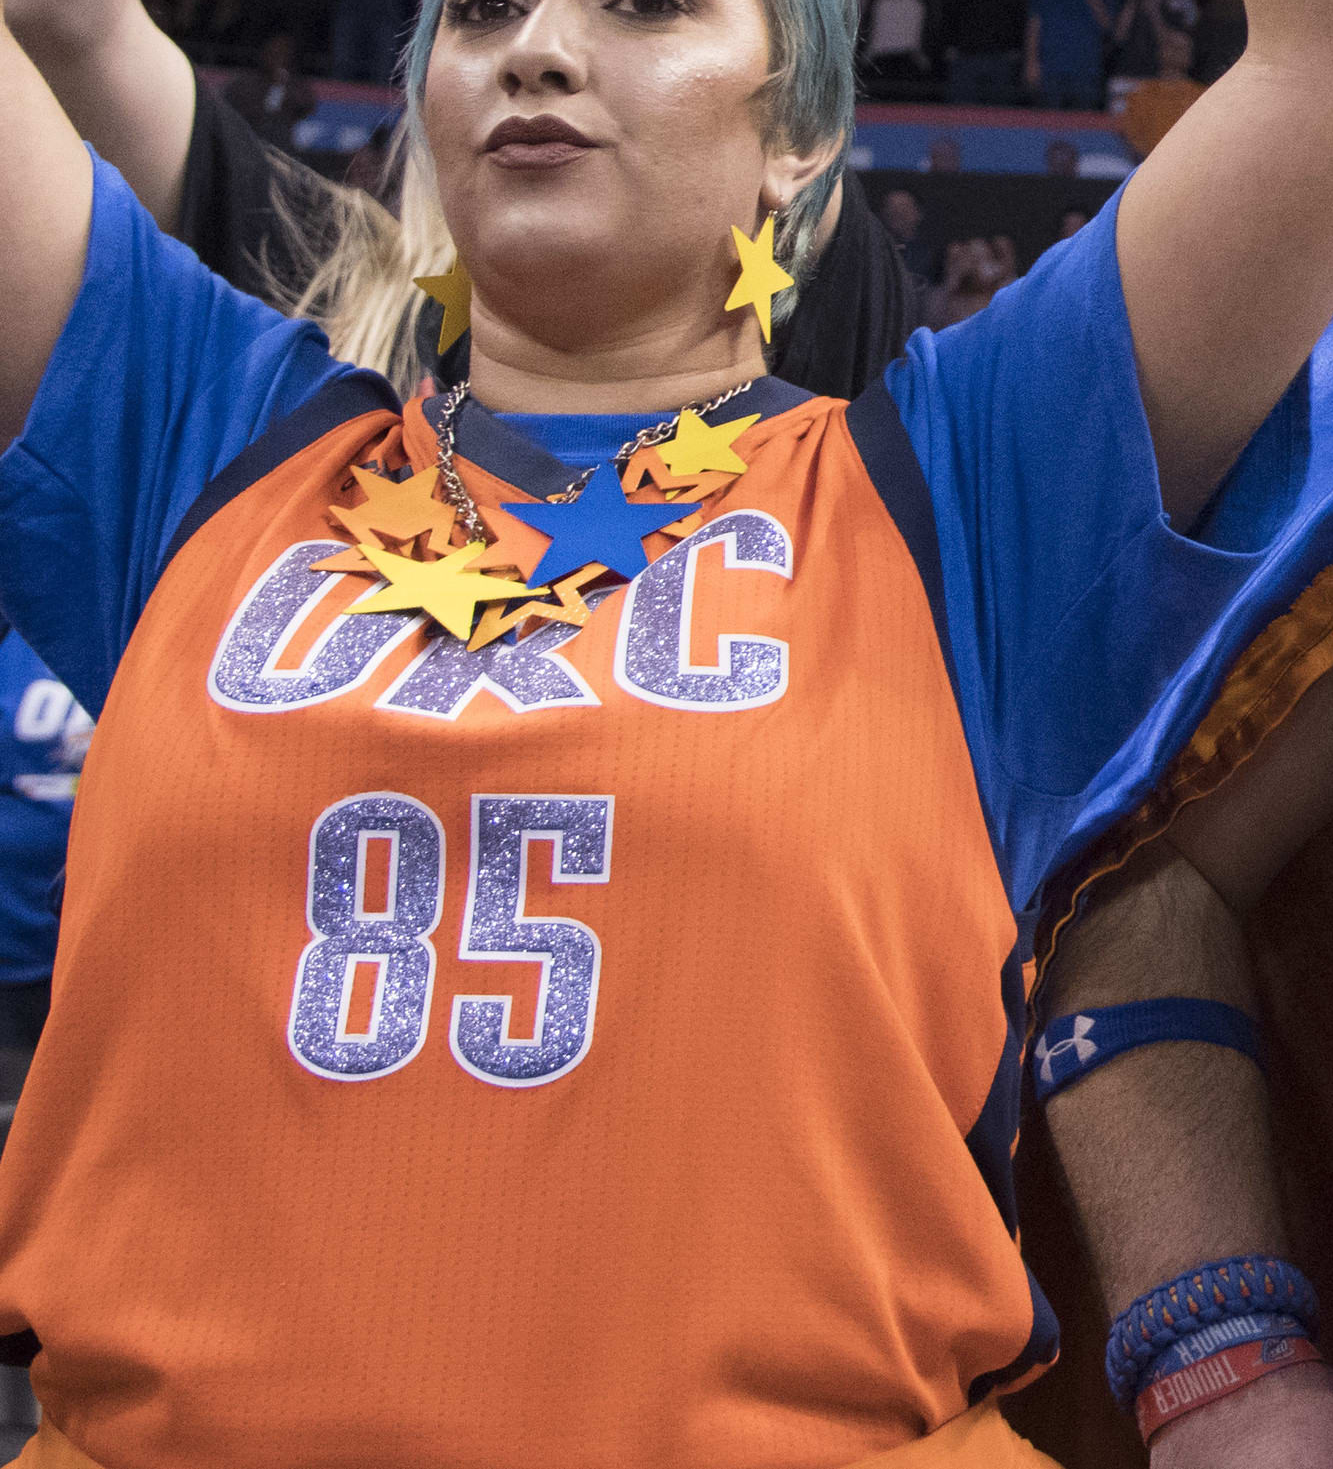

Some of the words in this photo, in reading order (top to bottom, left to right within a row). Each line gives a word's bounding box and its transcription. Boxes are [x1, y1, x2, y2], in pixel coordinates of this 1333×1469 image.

[286, 789, 617, 1089] 85
[1173, 1315, 1263, 1367] THUNDER
[1152, 1355, 1241, 1415] THUNDER
